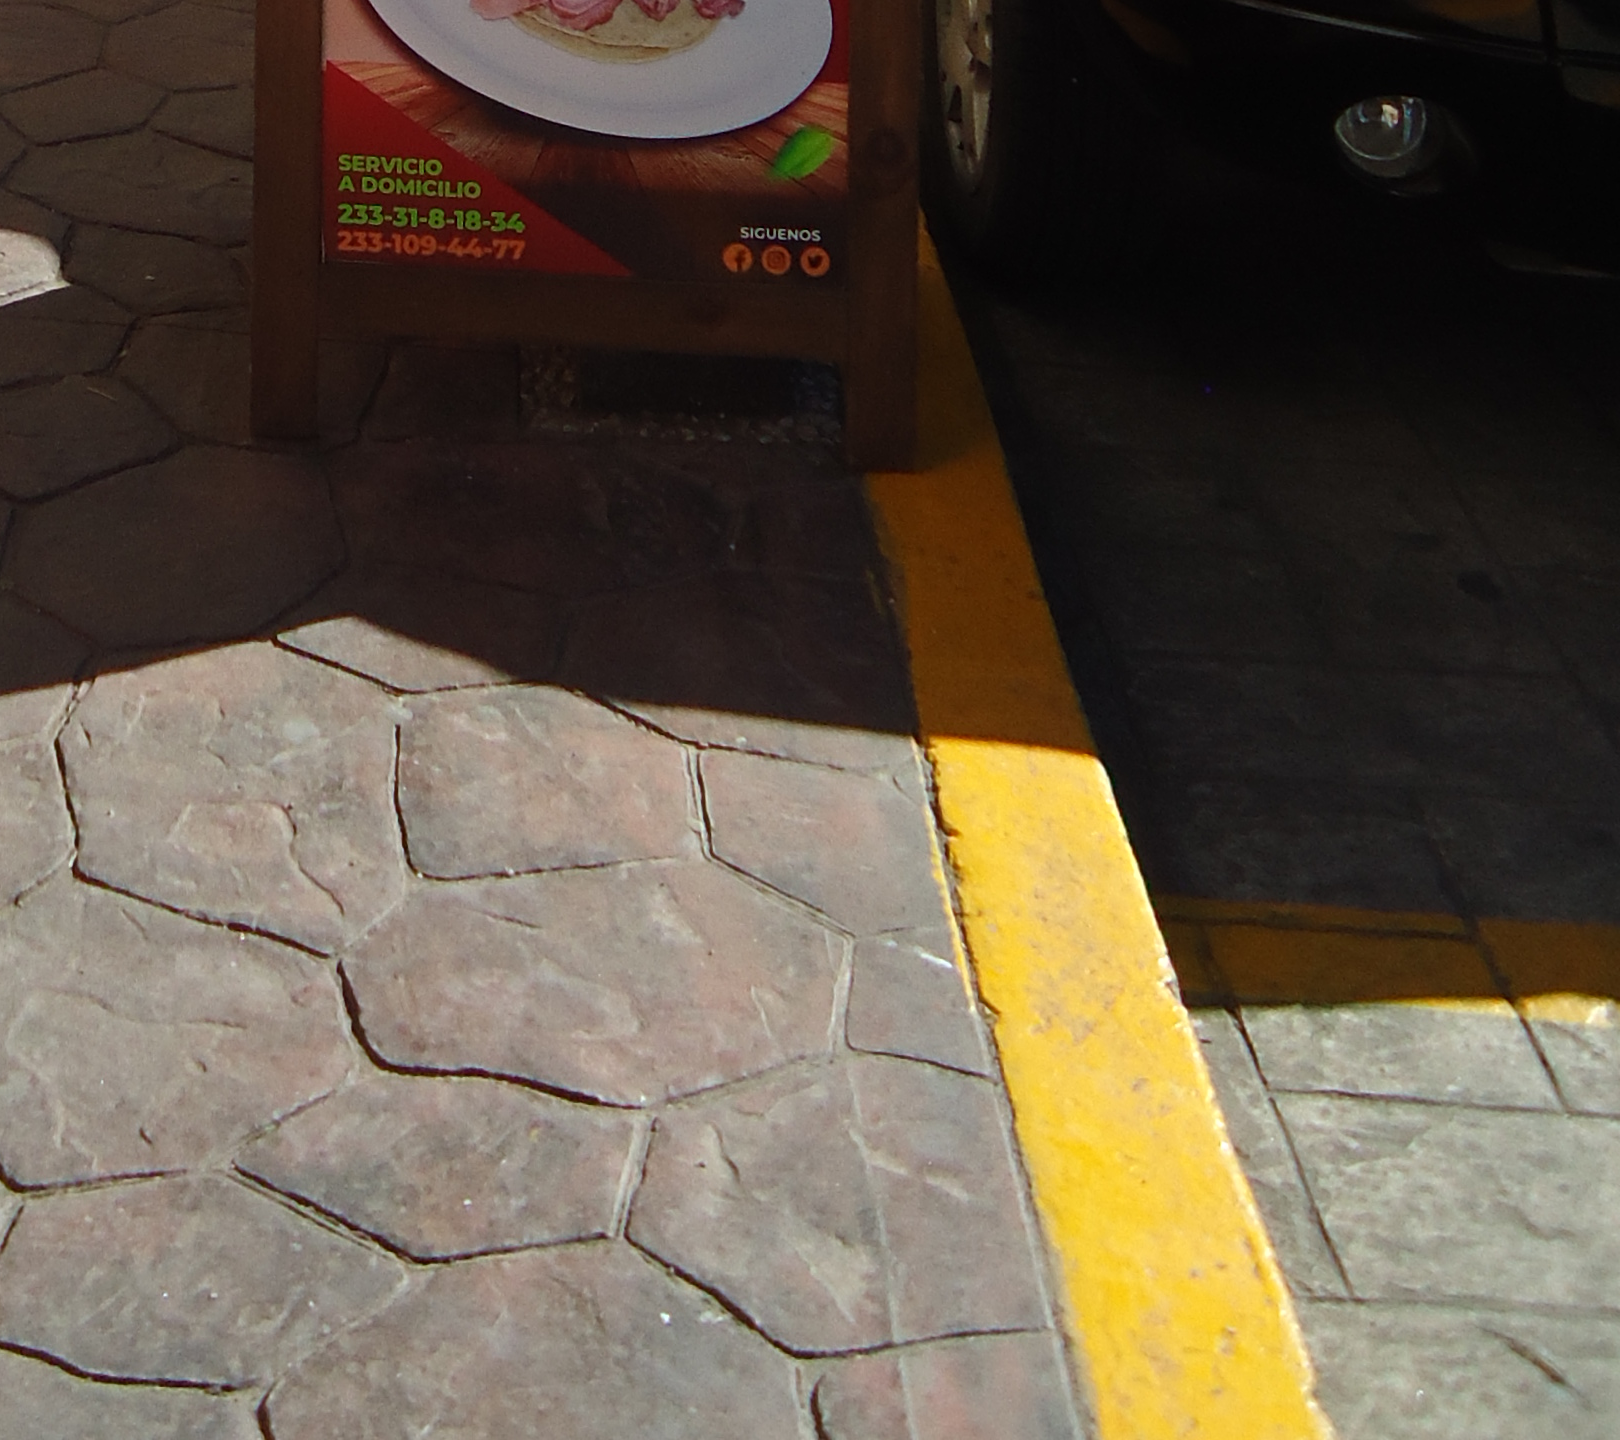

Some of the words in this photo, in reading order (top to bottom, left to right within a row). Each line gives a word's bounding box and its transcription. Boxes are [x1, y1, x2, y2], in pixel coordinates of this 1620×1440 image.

[338, 154, 443, 176] SERVICIO
[338, 175, 355, 193] A
[361, 176, 482, 199] DOMICILIO
[337, 203, 526, 233] 233-31-8-18-34
[337, 230, 526, 260] 233-109-44-77
[740, 226, 821, 242] SIGUENOS
